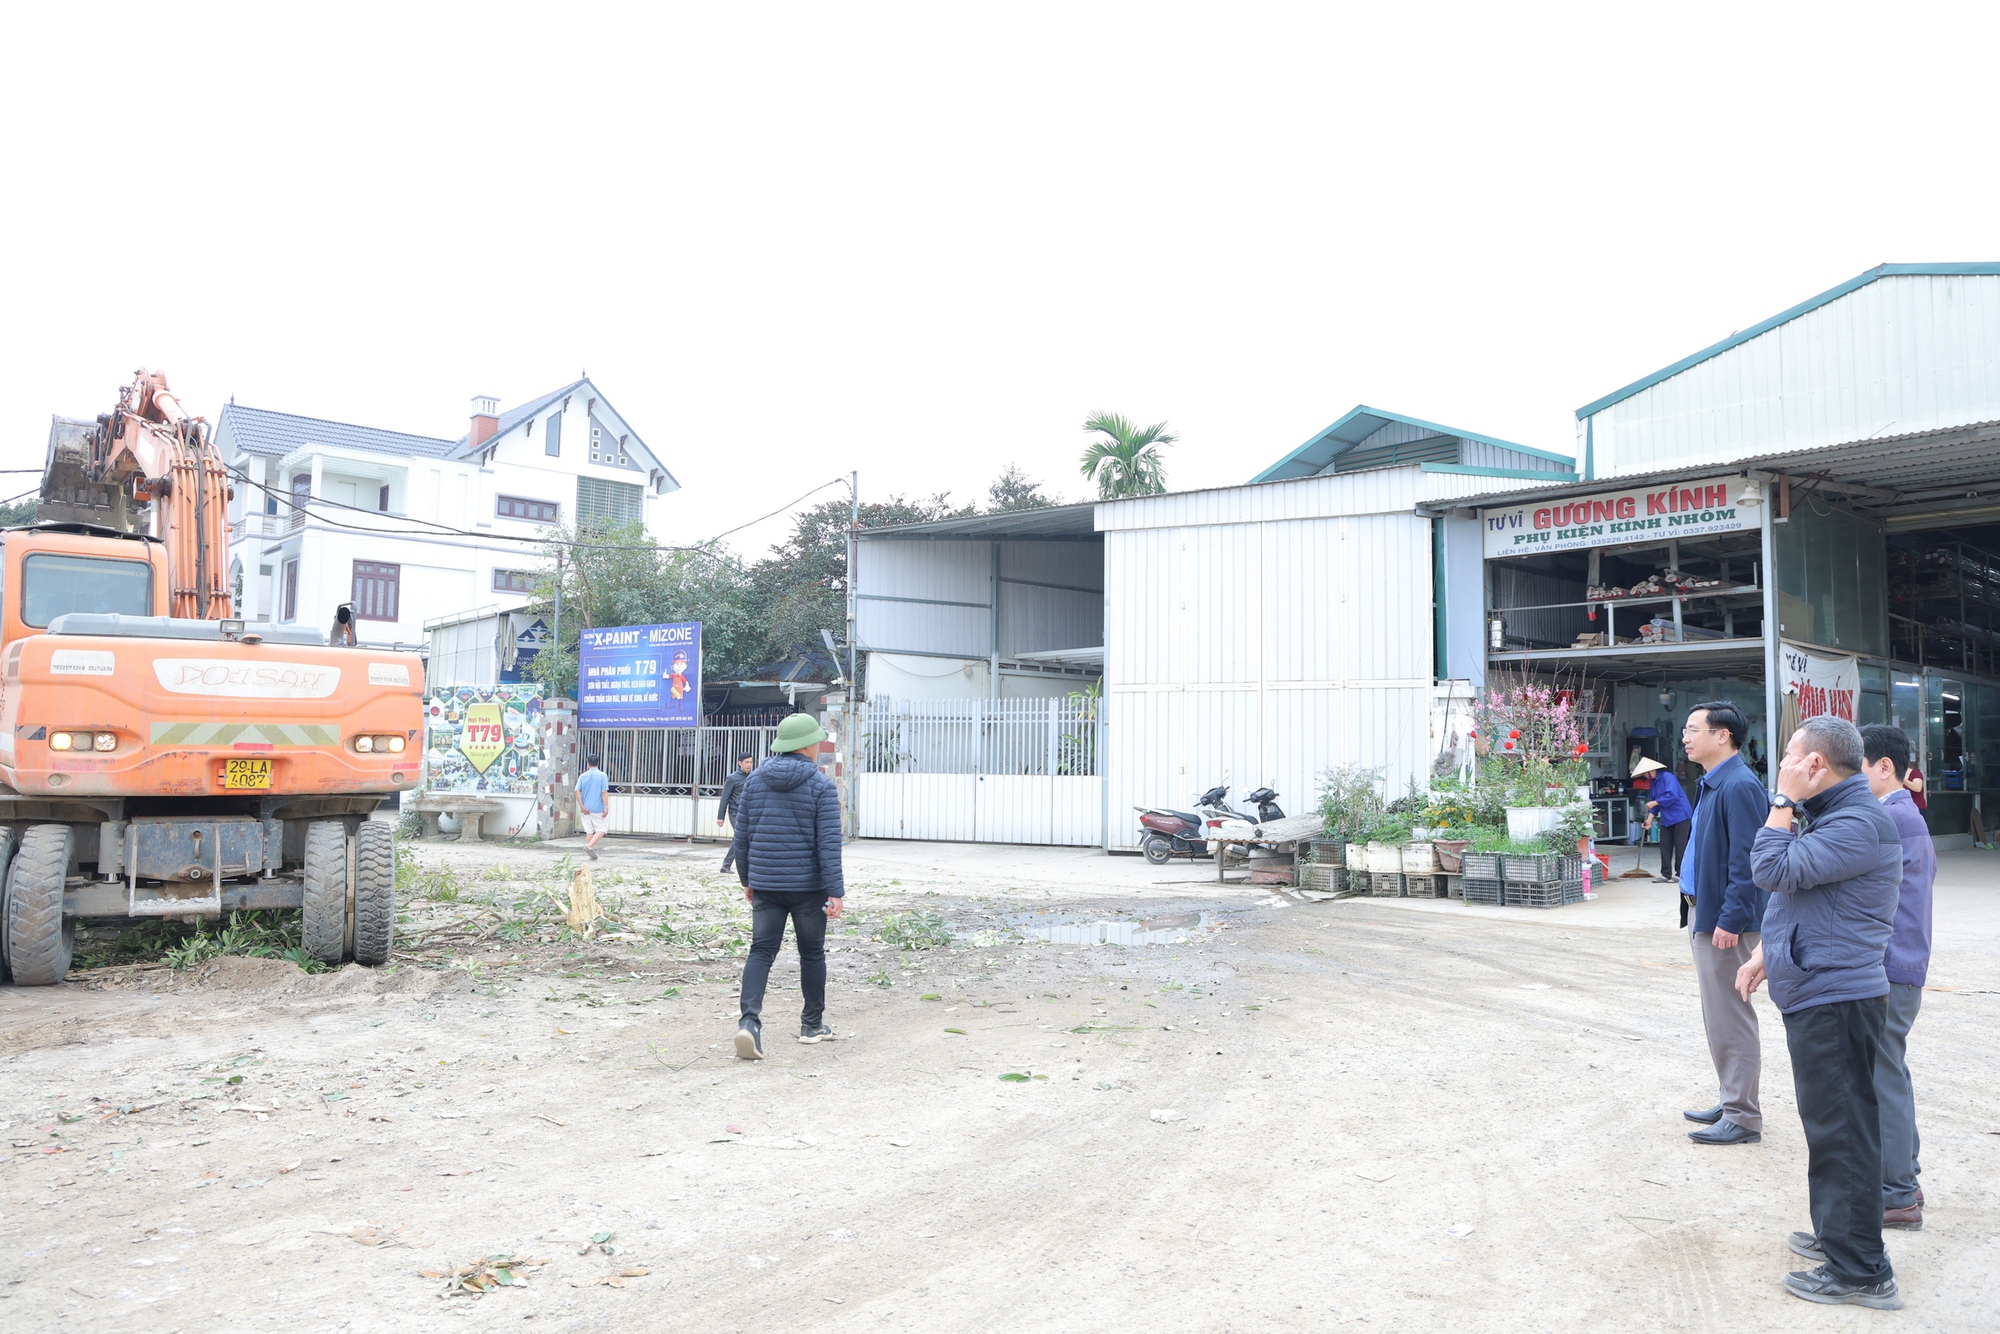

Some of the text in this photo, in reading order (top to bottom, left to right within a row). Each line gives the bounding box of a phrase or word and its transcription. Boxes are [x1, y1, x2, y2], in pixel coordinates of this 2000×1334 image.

[1533, 484, 1727, 530] GƯƠNG KÍNH
[1488, 510, 1524, 531] TƯ VĨ
[1514, 508, 1736, 545] PHỤ KIỆN KÍNH NHÔM
[1498, 548, 1516, 556] LIÊN
[650, 628, 692, 642] MIZONE
[588, 665, 600, 676] NHÀ
[617, 663, 631, 675] PHỐI
[635, 660, 657, 674] T79
[468, 724, 501, 742] T79
